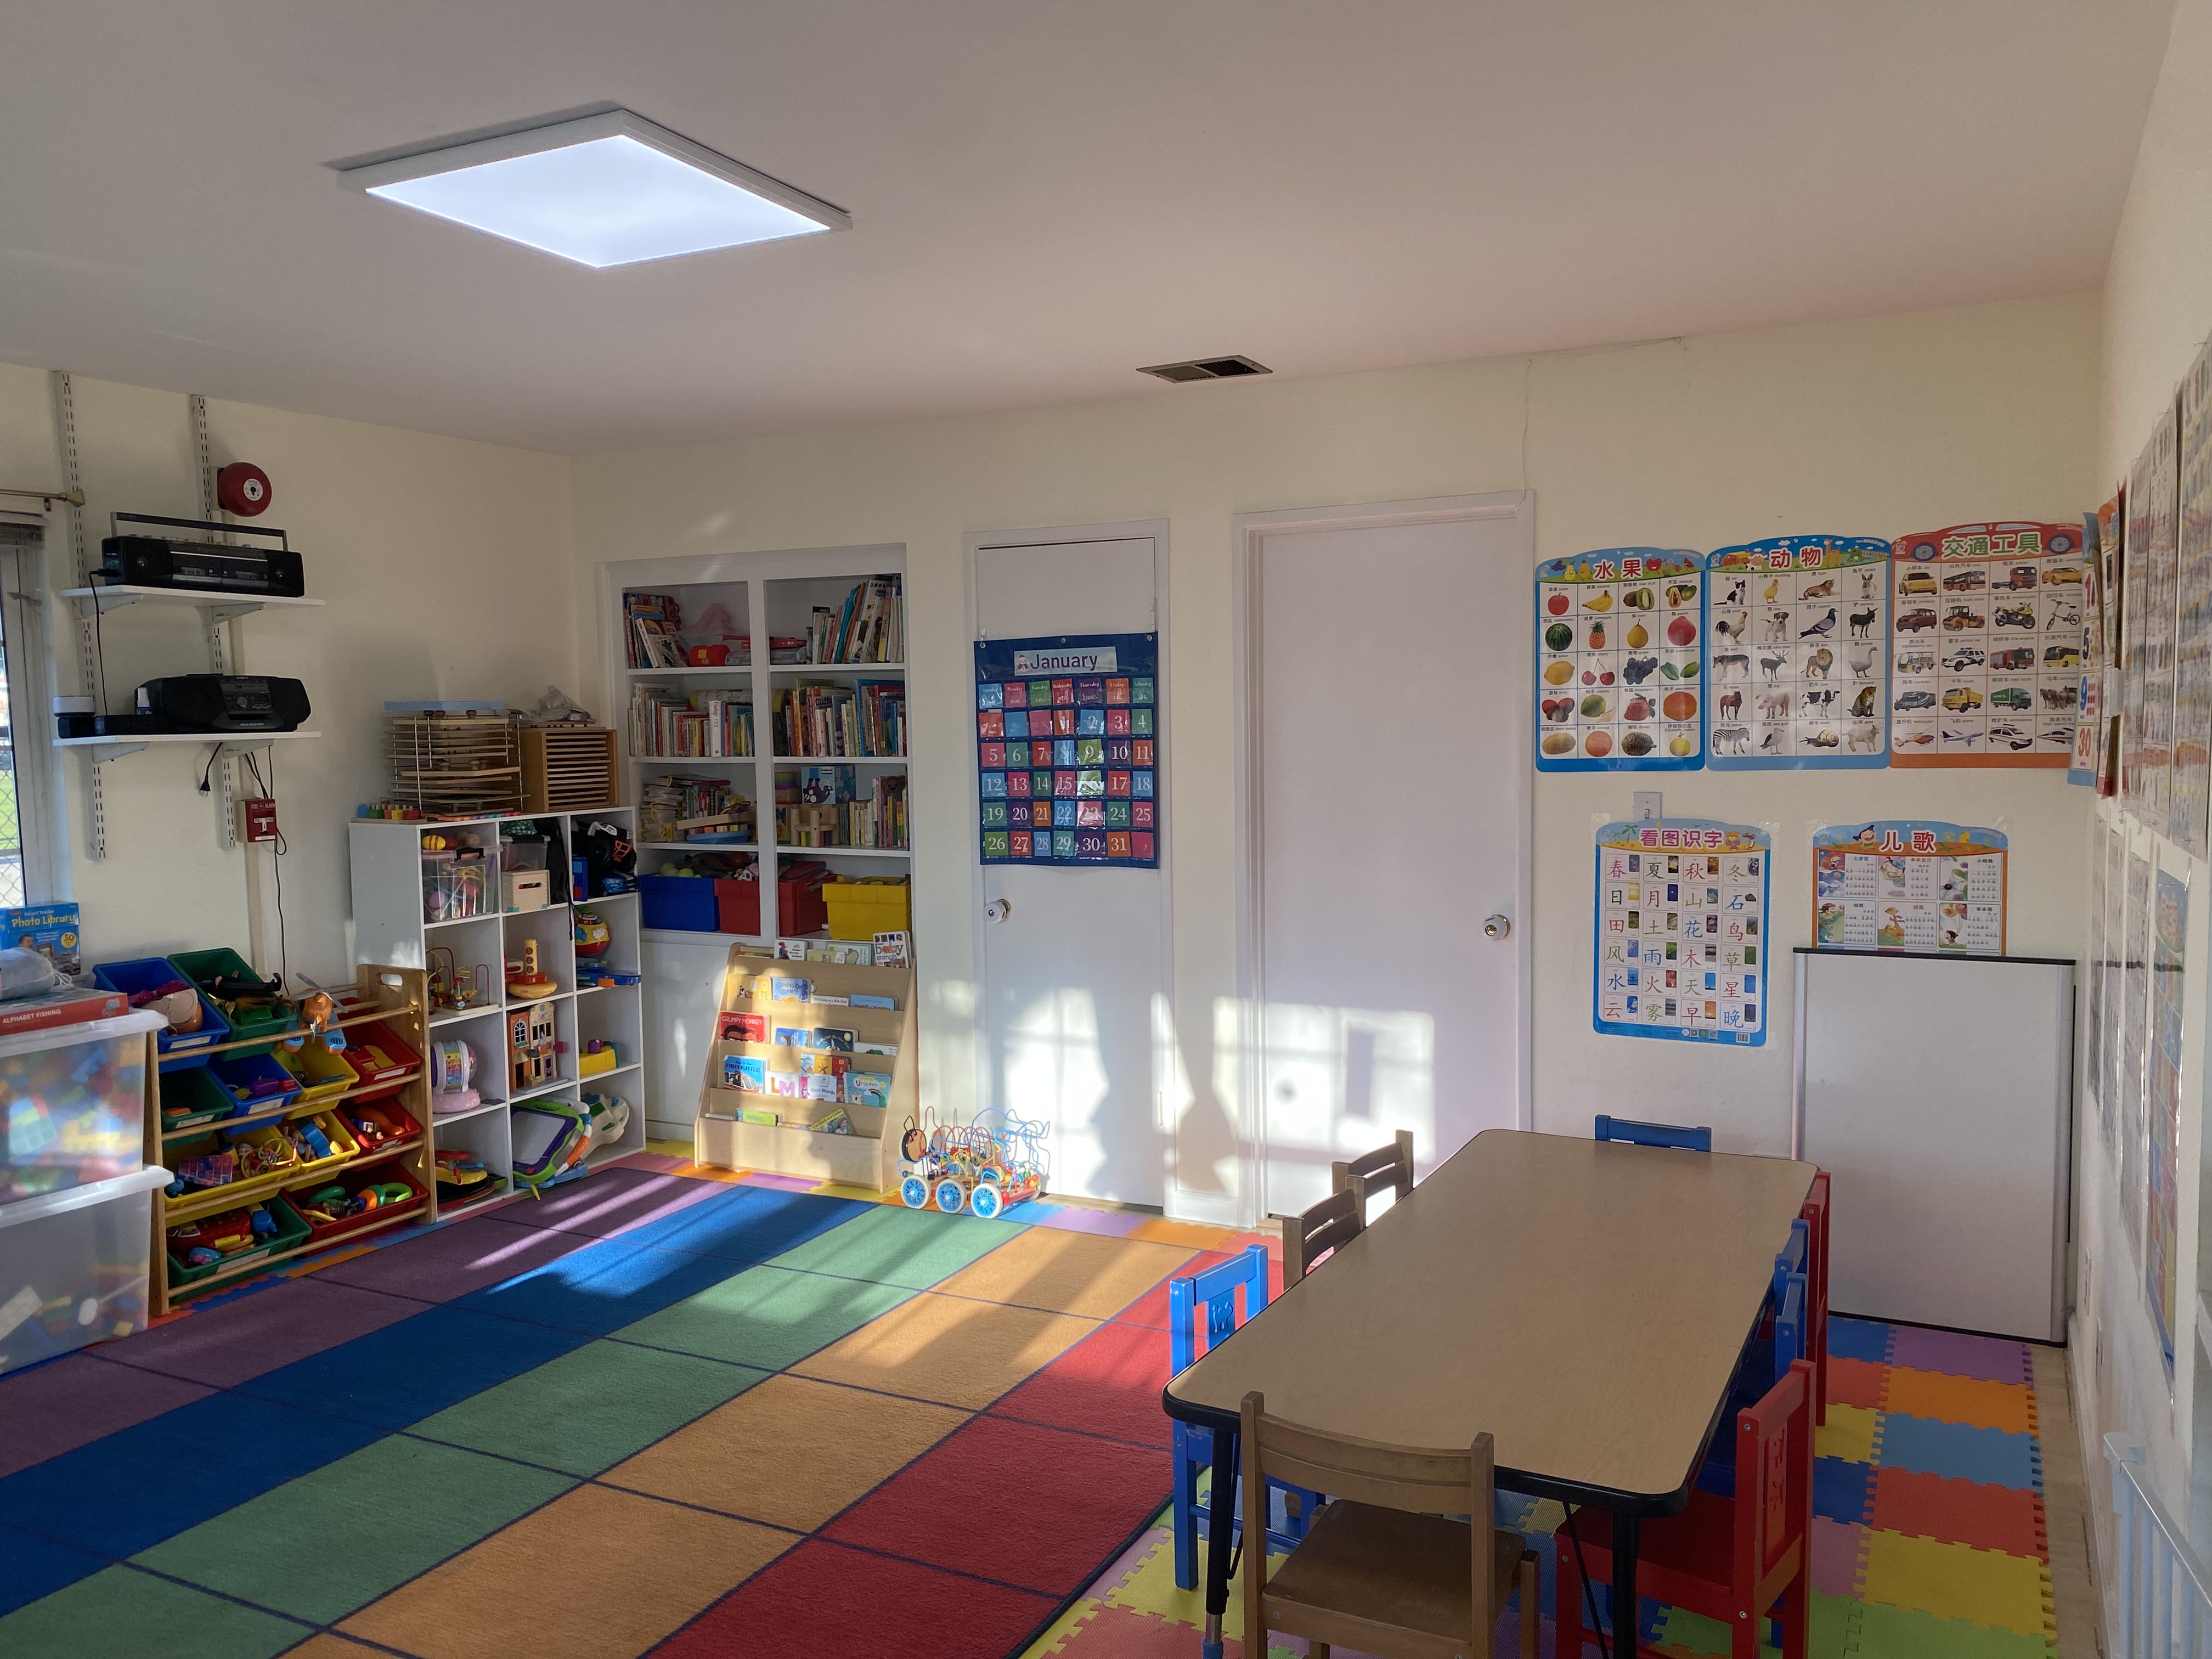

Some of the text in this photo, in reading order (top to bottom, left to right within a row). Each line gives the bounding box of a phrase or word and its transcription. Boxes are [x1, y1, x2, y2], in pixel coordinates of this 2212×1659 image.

[1943, 534, 2040, 557] 交通工具
[1771, 548, 1821, 568] 动物
[1594, 560, 1641, 579] 水果
[2083, 627, 2090, 660] 5
[1030, 654, 1098, 671] January
[2080, 676, 2087, 710] 9
[1088, 715, 1097, 730] 2
[1114, 715, 1123, 730] 3
[1138, 715, 1146, 728] 4
[2079, 727, 2091, 757] 30
[989, 748, 998, 761] 5
[1013, 748, 1022, 761] 6
[1037, 747, 1045, 760] 7
[1060, 746, 1067, 759] 8
[1087, 746, 1094, 759] 9
[1112, 746, 1128, 760] 10
[1136, 746, 1149, 759] 11
[987, 778, 1003, 791] 12
[1012, 777, 1028, 791] 13
[1036, 777, 1049, 791] 14
[1058, 777, 1072, 790] 15
[1112, 777, 1128, 791] 17
[1136, 777, 1150, 791] 18
[988, 808, 1004, 821] 19
[1012, 807, 1028, 820] 20
[1036, 807, 1049, 820] 21
[1057, 806, 1071, 821] 22
[1110, 807, 1127, 821] 24
[1136, 808, 1151, 821] 25
[988, 837, 1006, 850] 26
[1014, 837, 1029, 850] 27
[1036, 837, 1049, 850] 28
[1056, 837, 1071, 850] 29
[1082, 838, 1101, 851] 30
[1111, 838, 1127, 851] 31
[1640, 830, 1722, 848] 看图识字
[1881, 832, 1935, 851] 儿歌
[1606, 859, 1628, 878] 春
[1646, 862, 1665, 879] 夏
[1685, 862, 1706, 880] 秋
[1726, 864, 1747, 882] 冬
[1611, 889, 1622, 906] 日
[1647, 889, 1660, 908] 月
[1685, 893, 1702, 909] 山
[1725, 894, 1744, 910] 石
[11, 914, 76, 928] Photo Library
[1610, 919, 1624, 933] 田
[1644, 919, 1663, 935] 土
[1684, 921, 1703, 939] 花
[1727, 922, 1743, 941] 鸟
[1606, 946, 1624, 963] 风
[1644, 950, 1662, 966] 雨
[1681, 949, 1701, 968] 木
[1722, 952, 1742, 972] 草
[1607, 973, 1626, 990] 水
[1646, 975, 1663, 994] 火
[1684, 979, 1703, 996] 天
[1722, 981, 1741, 998] 星
[2, 1009, 61, 1024] ALPHABET FISHING
[1604, 1002, 1620, 1018] 云
[1645, 1003, 1664, 1022] 雾
[1681, 1007, 1702, 1025] 早
[721, 1015, 742, 1024] GRUMPY
[1724, 1011, 1744, 1029] 晚
[725, 1063, 760, 1073] FIREFIGHTER
